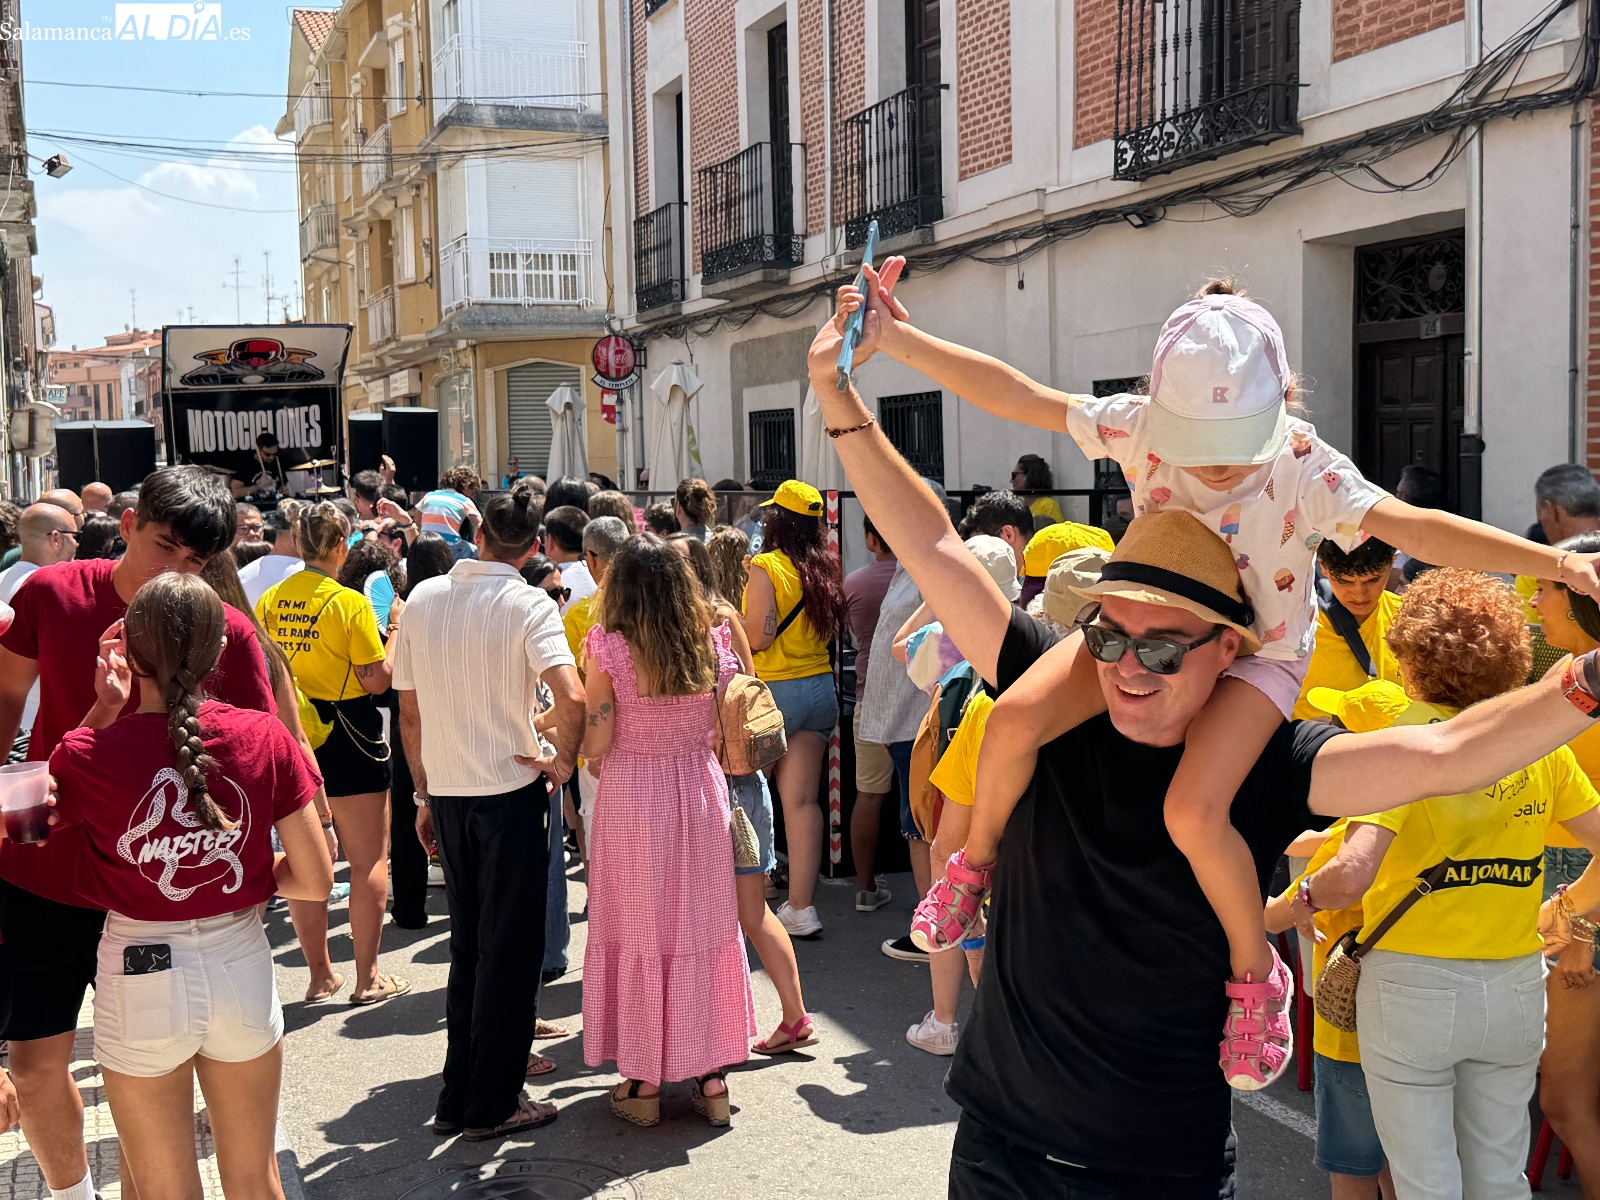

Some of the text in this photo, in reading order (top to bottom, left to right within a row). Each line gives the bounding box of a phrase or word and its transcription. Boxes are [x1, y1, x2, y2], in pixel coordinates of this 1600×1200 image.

[186, 403, 323, 454] MOTOCICLONES
[277, 599, 307, 611] EN MI
[279, 612, 318, 625] MUNDO
[277, 628, 320, 640] EL RARO
[1443, 863, 1532, 885] ALJOMAR
